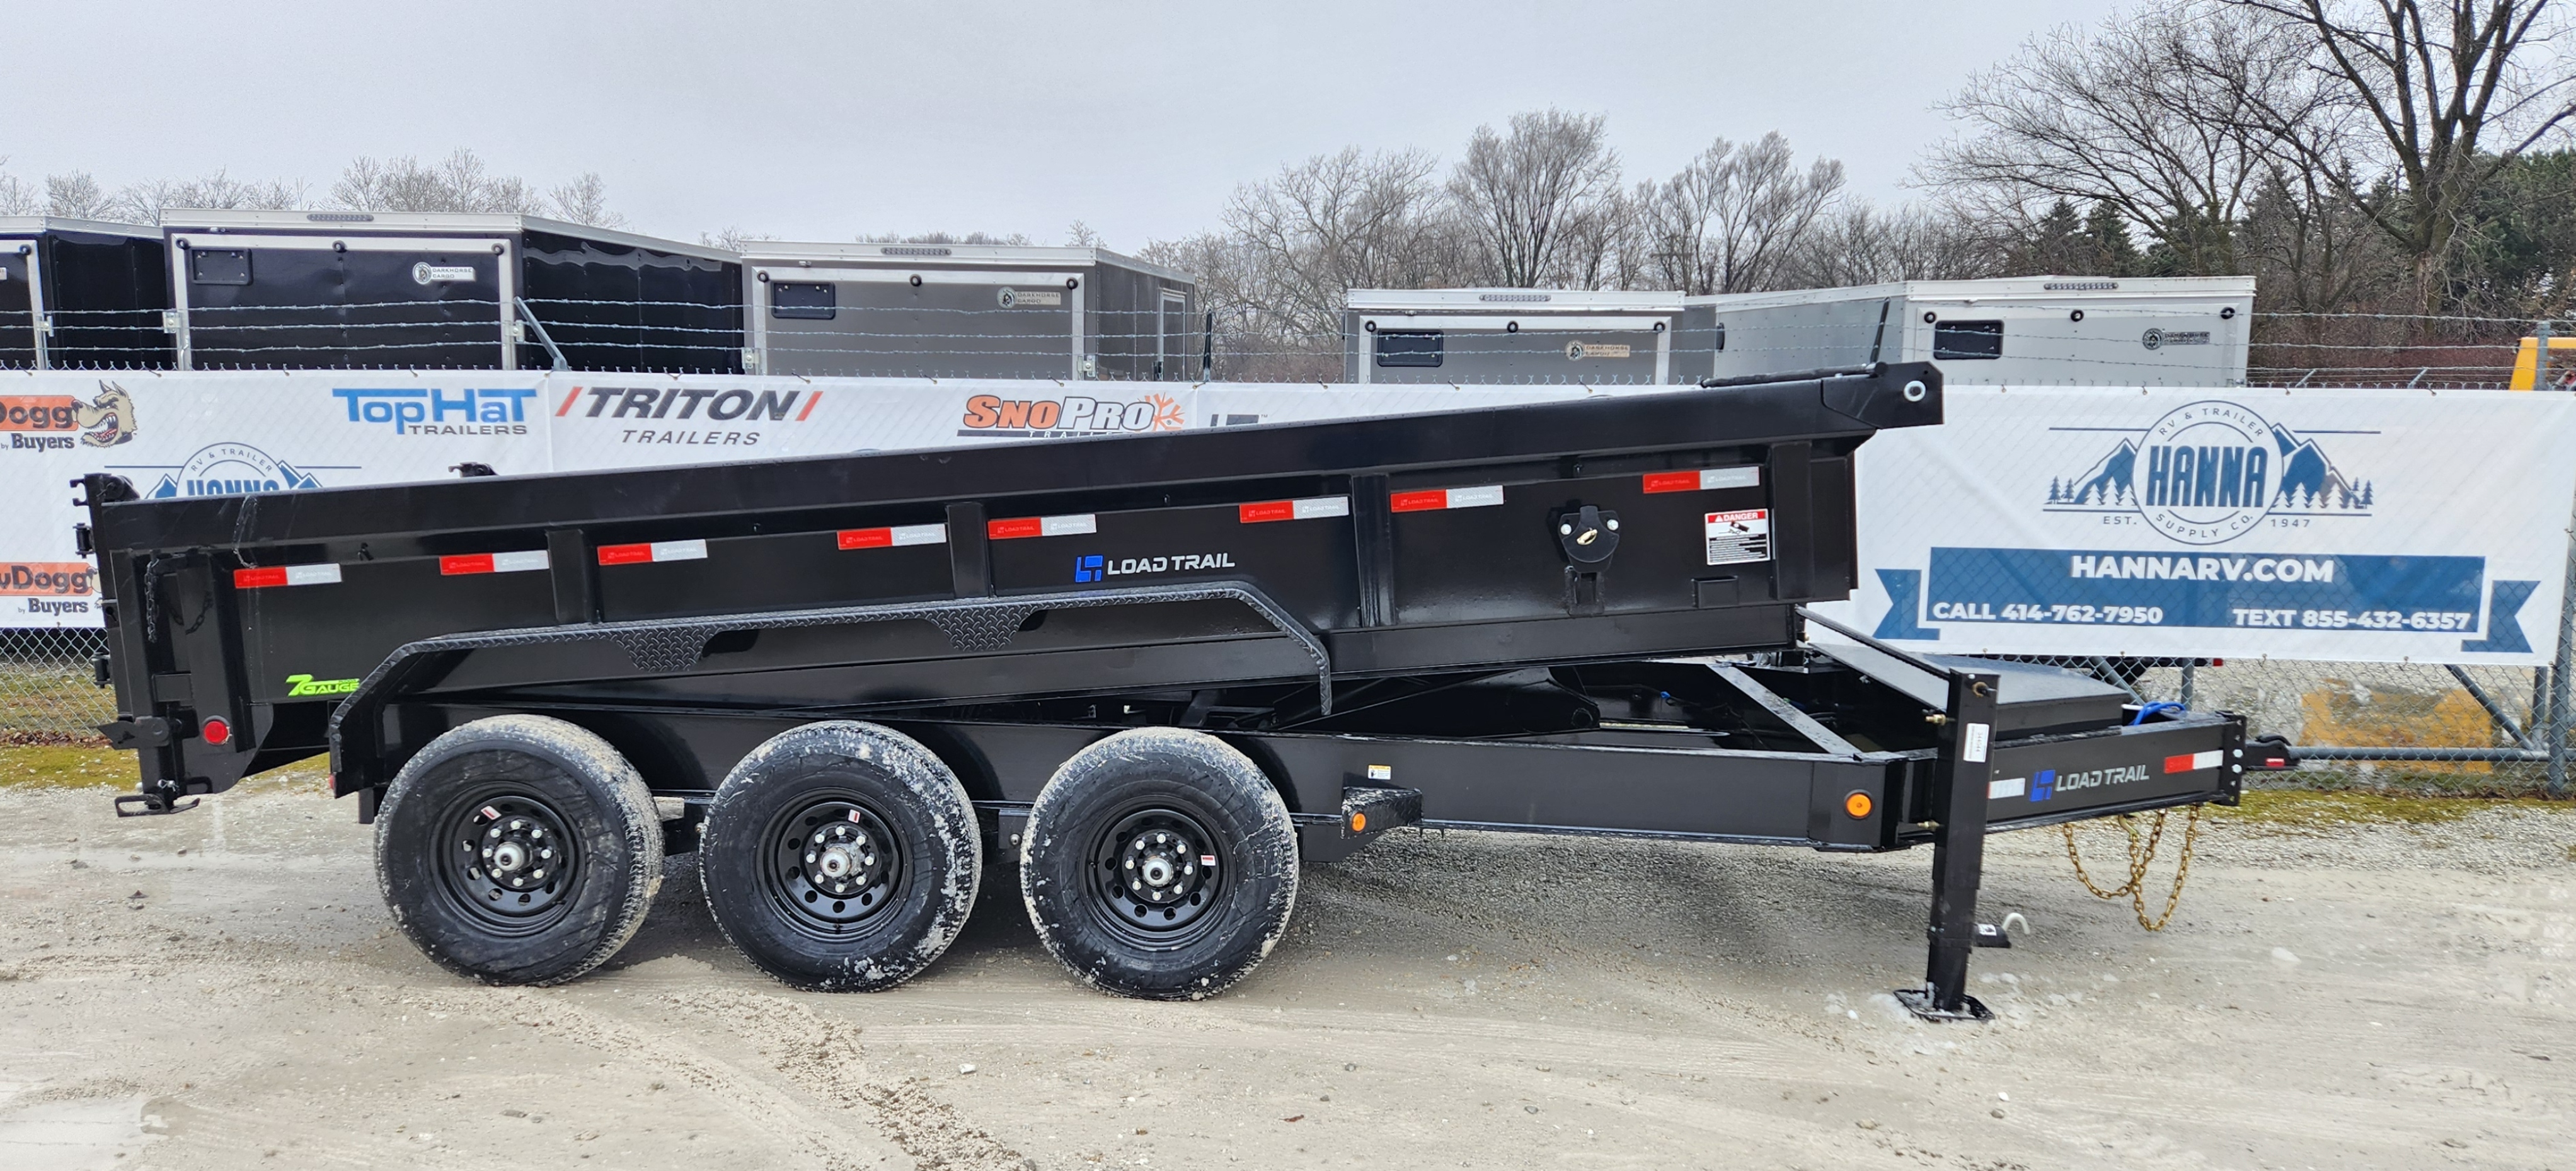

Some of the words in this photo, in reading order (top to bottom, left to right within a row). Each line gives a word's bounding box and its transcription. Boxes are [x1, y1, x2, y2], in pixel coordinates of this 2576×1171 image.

[585, 386, 801, 421] TRITON
[408, 425, 527, 435] TRAILERS
[2159, 420, 2175, 436] RV
[2185, 412, 2193, 420] &
[2202, 408, 2263, 437] TRAILER
[11, 432, 75, 453] Buyers
[622, 430, 761, 445] TRAILERS
[190, 458, 203, 471] RV
[221, 448, 272, 472] TRAILER
[2145, 445, 2268, 508] HANNA
[1723, 512, 1759, 522] DANGER
[2103, 516, 2137, 525] EST.
[2156, 513, 2219, 538] SUPPLY
[2231, 514, 2253, 531] CO.
[2270, 518, 2311, 528] 1947
[1107, 557, 1168, 575] LOAD
[1171, 553, 1236, 570] TRAIL
[2071, 555, 2334, 582] HANNARV.COM
[18, 606, 26, 614] by
[27, 597, 89, 616] Buyers
[1932, 602, 1996, 620] CALL
[2001, 603, 2163, 624] 414-762-7950
[2233, 609, 2297, 626] TEXT
[2301, 609, 2471, 630] 855-432-6357
[299, 681, 360, 695] GAUGE
[2055, 770, 2103, 792] LOAD
[2105, 764, 2150, 785] TRAIL
